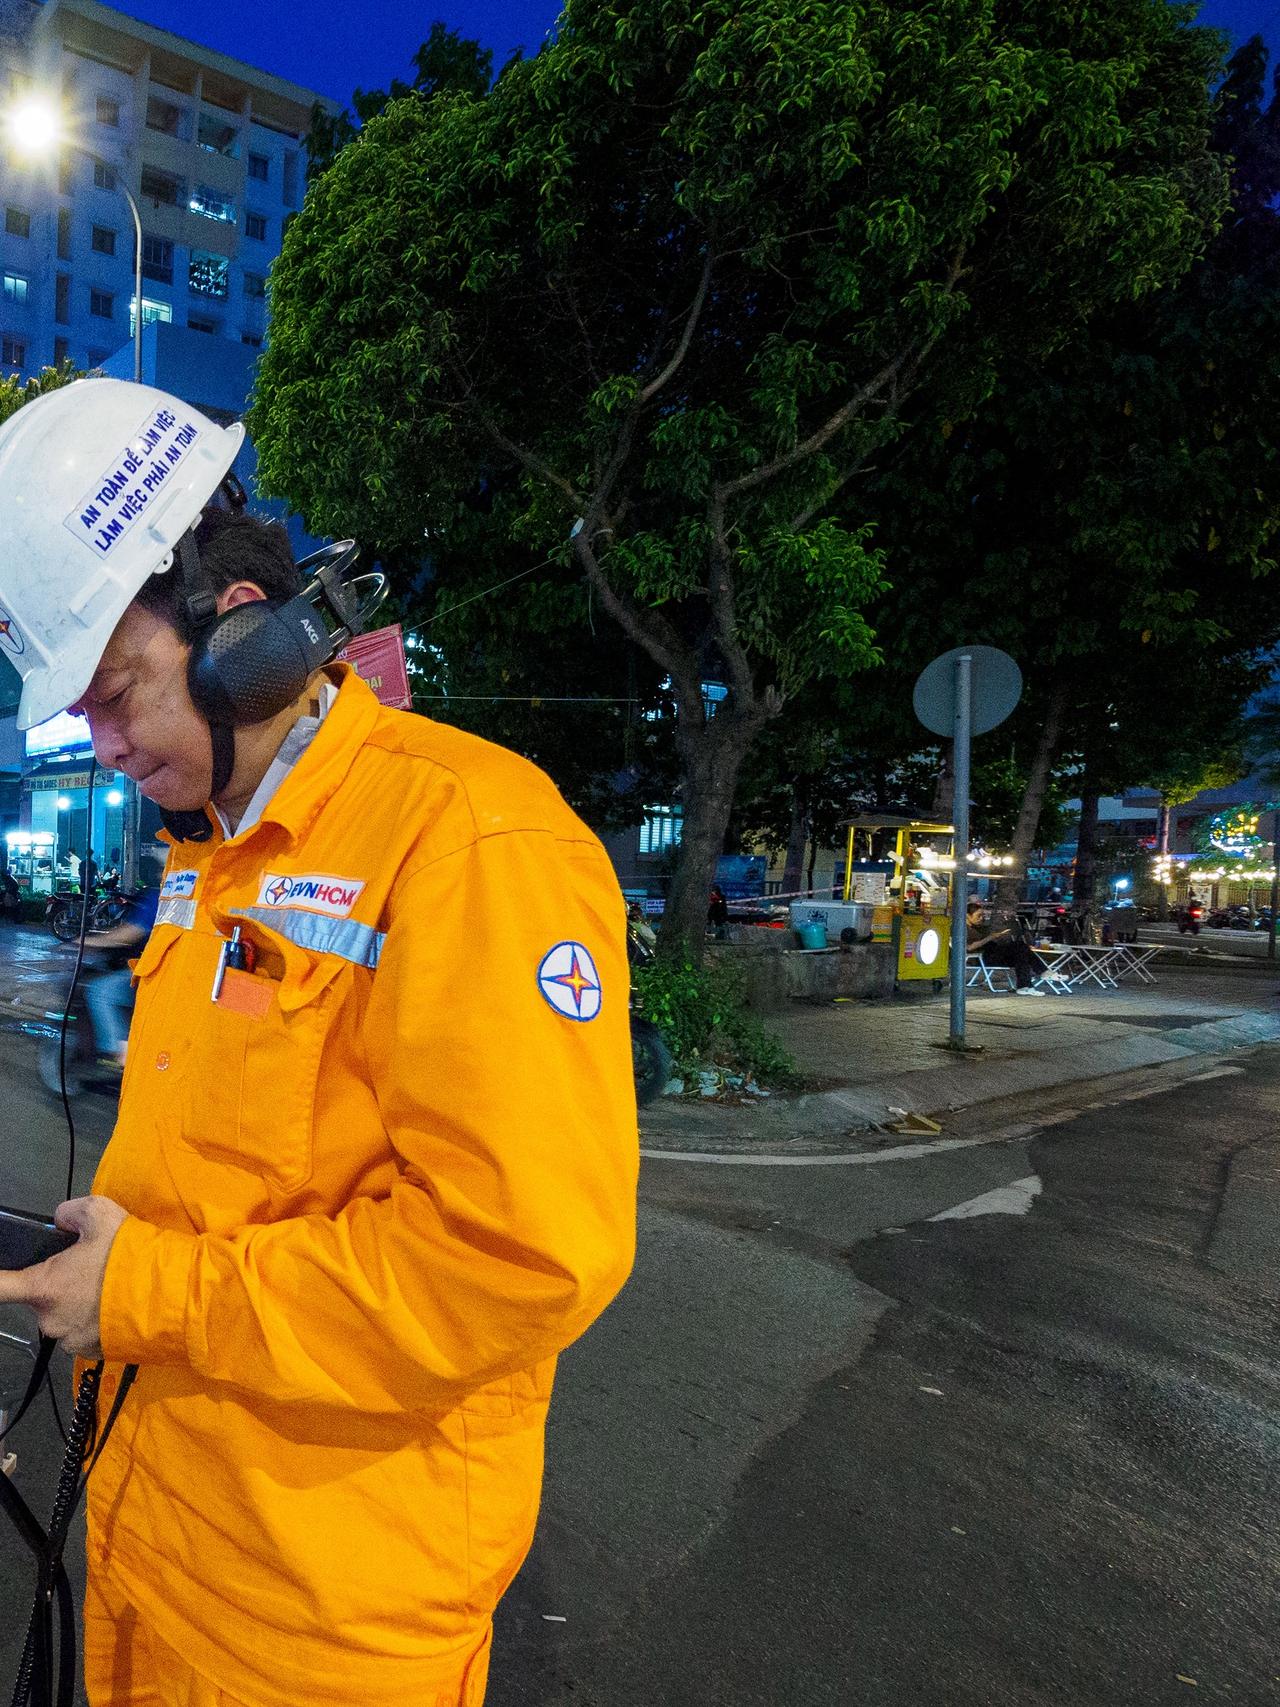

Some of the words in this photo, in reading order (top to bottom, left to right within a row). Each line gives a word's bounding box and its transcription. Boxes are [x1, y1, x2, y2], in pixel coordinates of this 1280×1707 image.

[80, 504, 101, 529] AN
[94, 470, 129, 507] TOÀN
[122, 447, 144, 474] ĐỂ
[138, 429, 162, 456] LÀM
[153, 410, 176, 433] VIỆC
[94, 518, 124, 552] LÀM
[118, 489, 148, 521] VIỆC
[142, 459, 170, 493] PHẢI
[164, 444, 182, 465] AN
[174, 423, 198, 449] TOÀN
[300, 619, 319, 644] AKG
[58, 777, 72, 787] HY
[289, 882, 358, 906] EVNHCM
